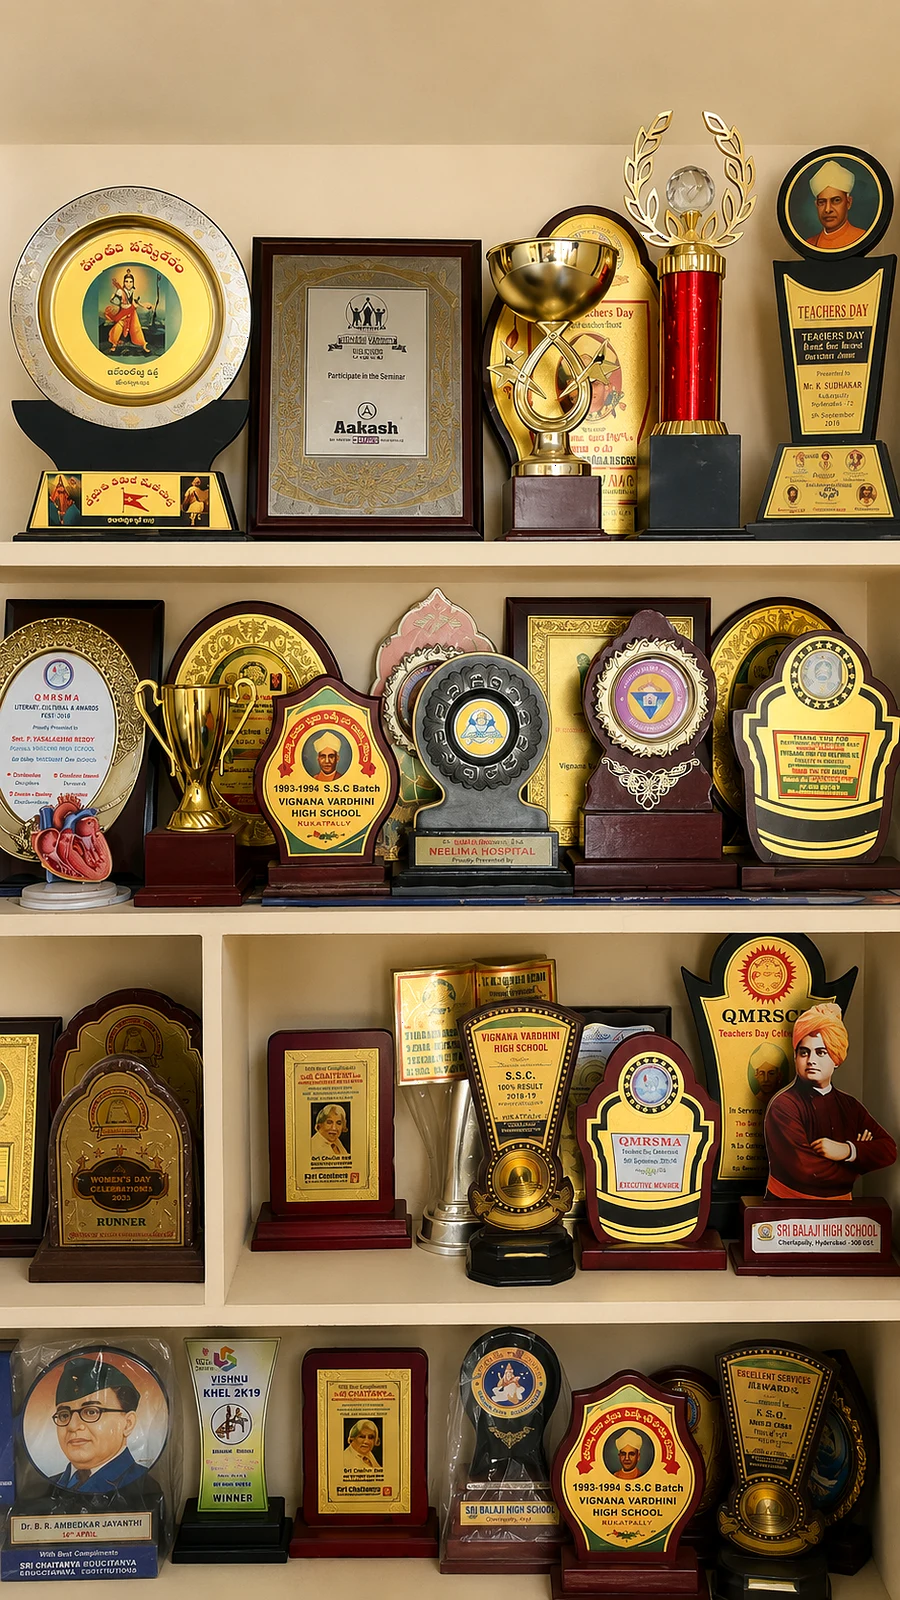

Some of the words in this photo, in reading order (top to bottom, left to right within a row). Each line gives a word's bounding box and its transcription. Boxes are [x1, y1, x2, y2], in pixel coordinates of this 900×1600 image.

[584, 308, 614, 318] chers
[616, 307, 634, 320] Day
[797, 304, 847, 319] TEACHERS
[849, 303, 869, 318] DAY
[846, 331, 865, 340] DAY
[328, 372, 360, 380] Participate
[380, 372, 405, 380] Seminar
[816, 382, 822, 390] K
[334, 420, 399, 434] Aakash
[558, 762, 587, 771] Vignana
[352, 784, 380, 792] Batch
[278, 797, 324, 806] VIGNANA
[327, 797, 375, 806] VARDHINI
[291, 810, 317, 818] HIGH
[320, 810, 362, 818] SCHOOL
[429, 848, 478, 856] NEELIMA
[482, 848, 536, 856] HOSPITAL
[722, 1008, 806, 1026] QMRSC
[520, 1031, 560, 1041] VARDHINI
[718, 1029, 753, 1038] Teachers
[755, 1029, 769, 1040] Day
[619, 1136, 682, 1147] QMRSMA
[96, 1217, 147, 1226] RUNNER
[776, 1224, 790, 1237] SRI
[792, 1224, 820, 1237] BALAJI
[823, 1224, 843, 1237] HIGH
[844, 1224, 878, 1237] SCHOOL
[211, 1375, 248, 1384] VISHNU
[203, 1388, 231, 1398] KHEL
[234, 1388, 261, 1398] 2K19
[572, 1484, 620, 1492] 1993-1994
[655, 1484, 684, 1492] Batch
[212, 1494, 253, 1502] WINNER
[579, 1496, 626, 1505] VIGNANA
[628, 1497, 677, 1505] VARDHINI
[479, 1506, 505, 1514] BALAJI
[592, 1508, 618, 1516] HIGH
[621, 1508, 663, 1516] SCHOOL
[20, 1522, 32, 1530] Dr.
[34, 1522, 42, 1530] B.
[54, 1520, 100, 1530] AMBEDKAR
[102, 1519, 142, 1528] JAYANTHI
[20, 1562, 34, 1570] SRI
[35, 1560, 81, 1569] CHAITANYA
